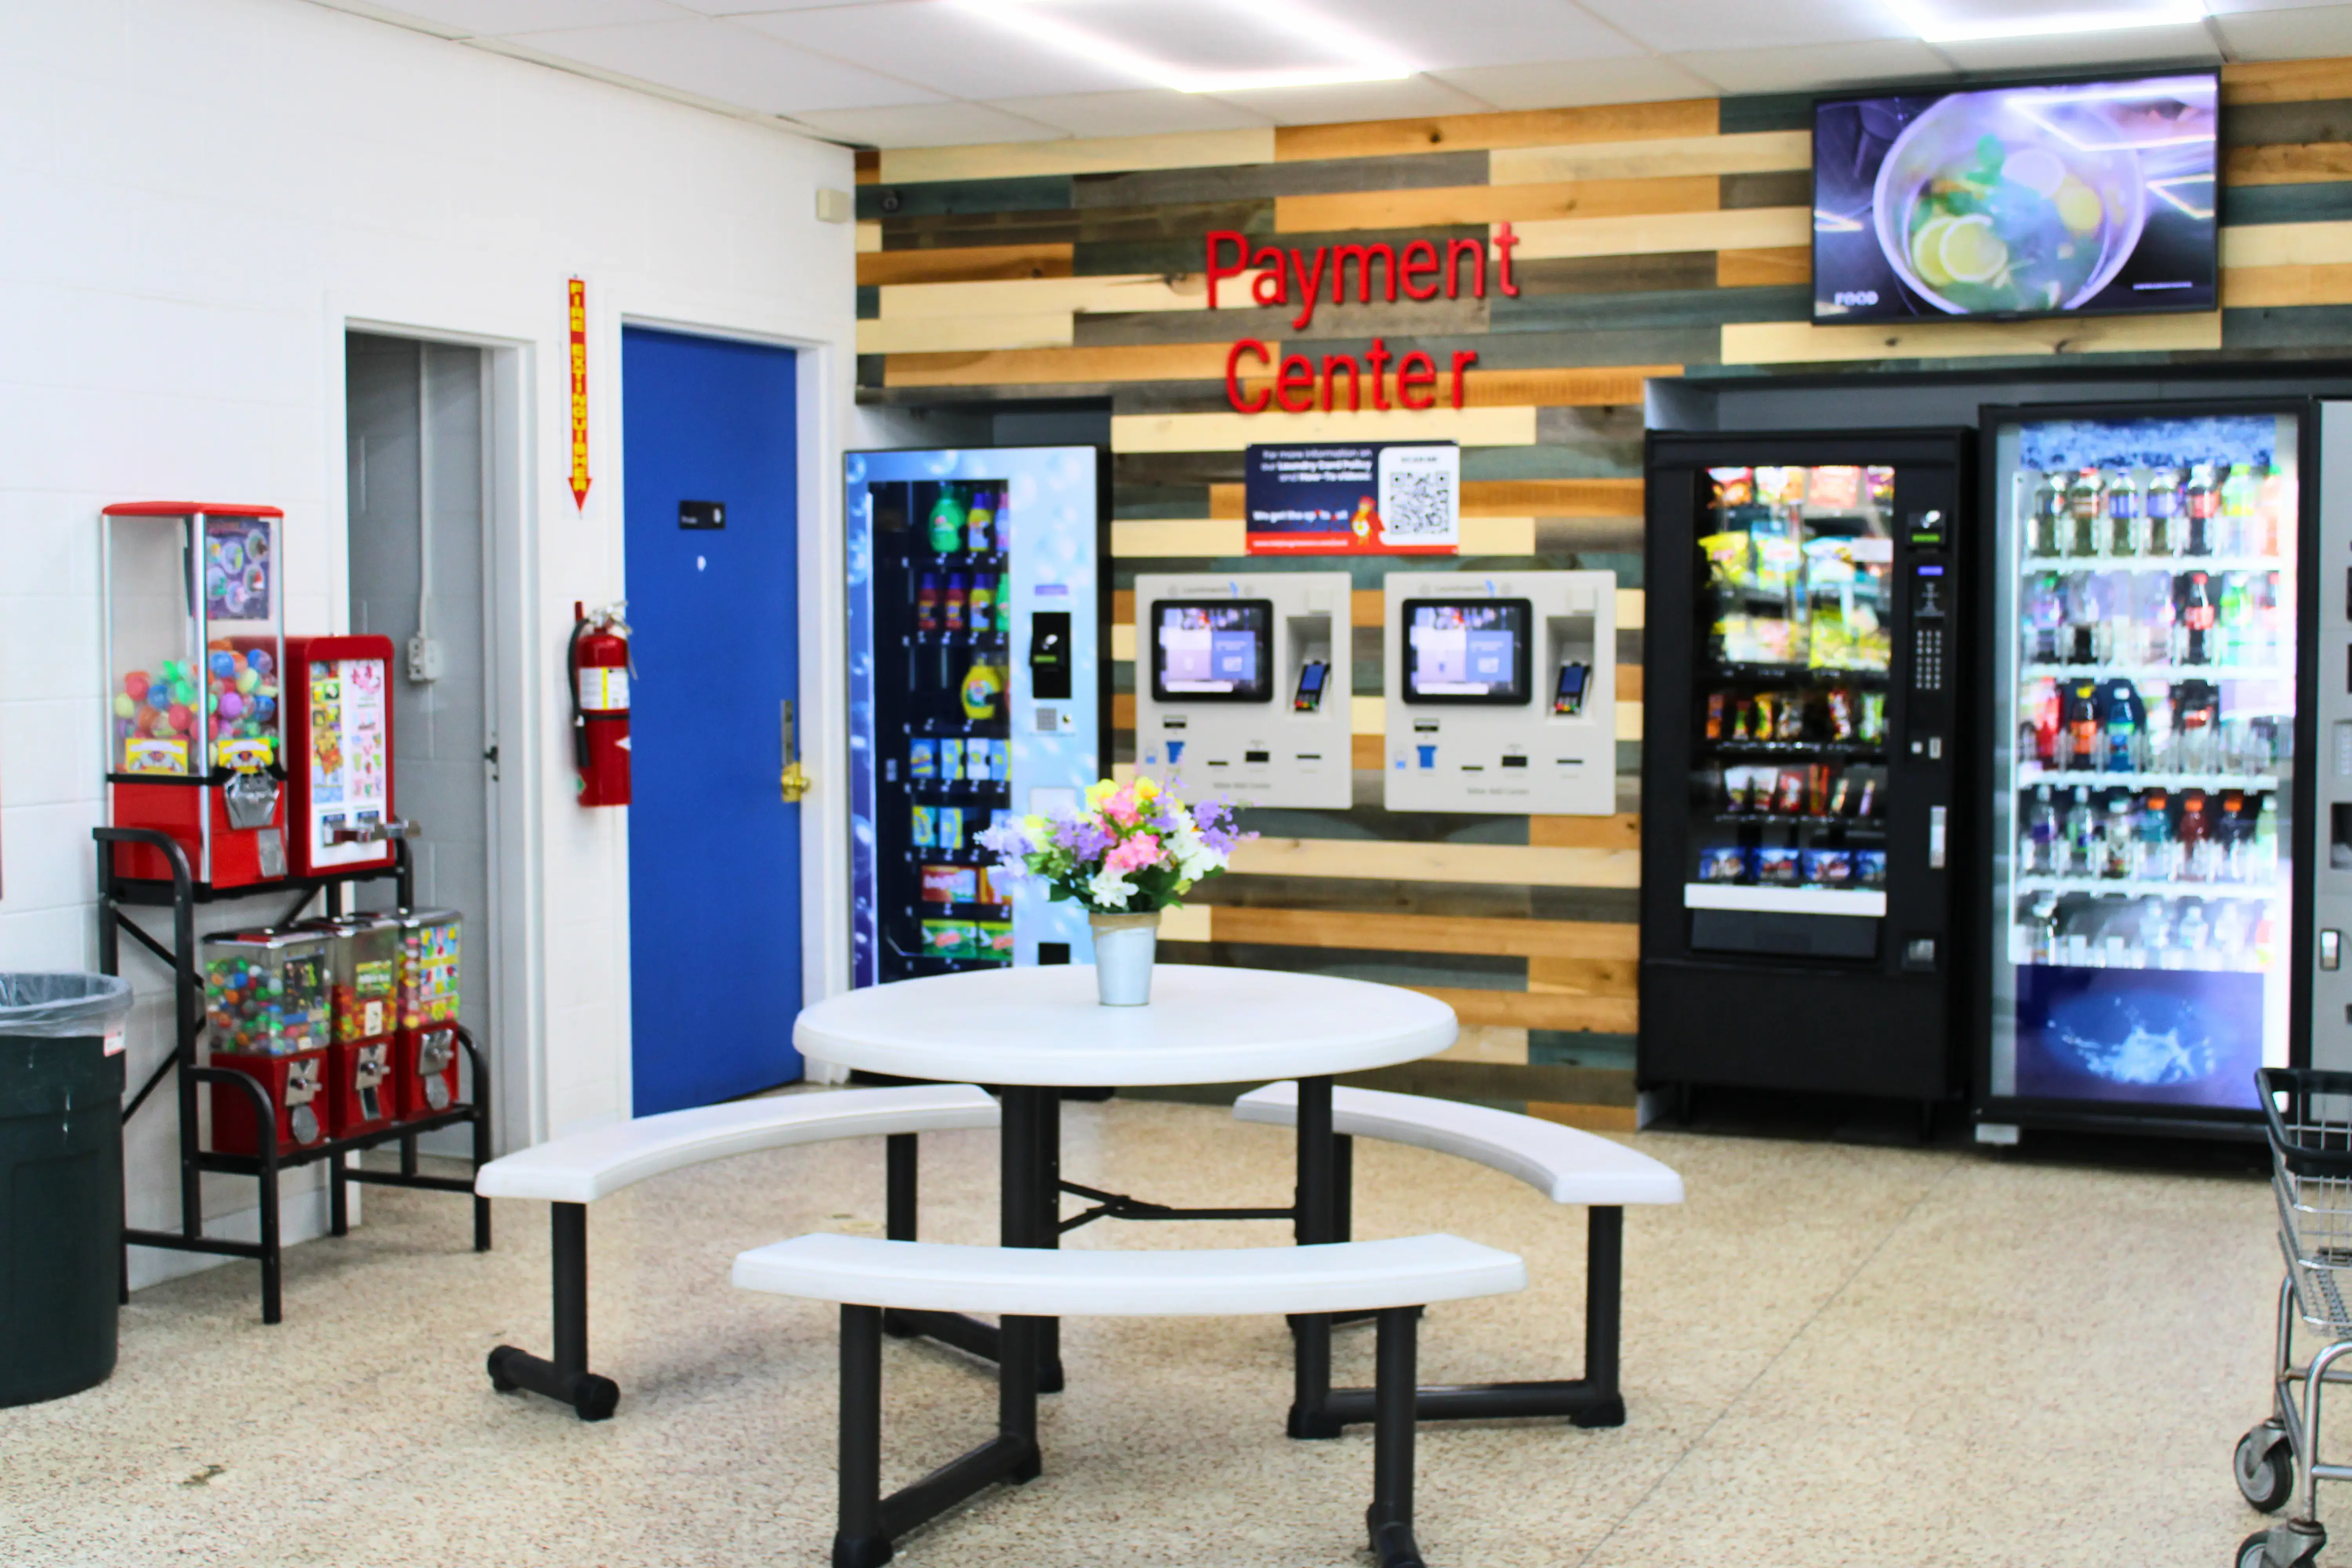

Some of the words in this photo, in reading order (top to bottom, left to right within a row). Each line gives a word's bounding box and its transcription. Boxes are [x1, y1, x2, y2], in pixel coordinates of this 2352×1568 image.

[570, 281, 585, 332] FIRE
[1207, 221, 1519, 329] Payment
[572, 343, 588, 492] EXTINGUISHER
[1226, 338, 1478, 414] Center
